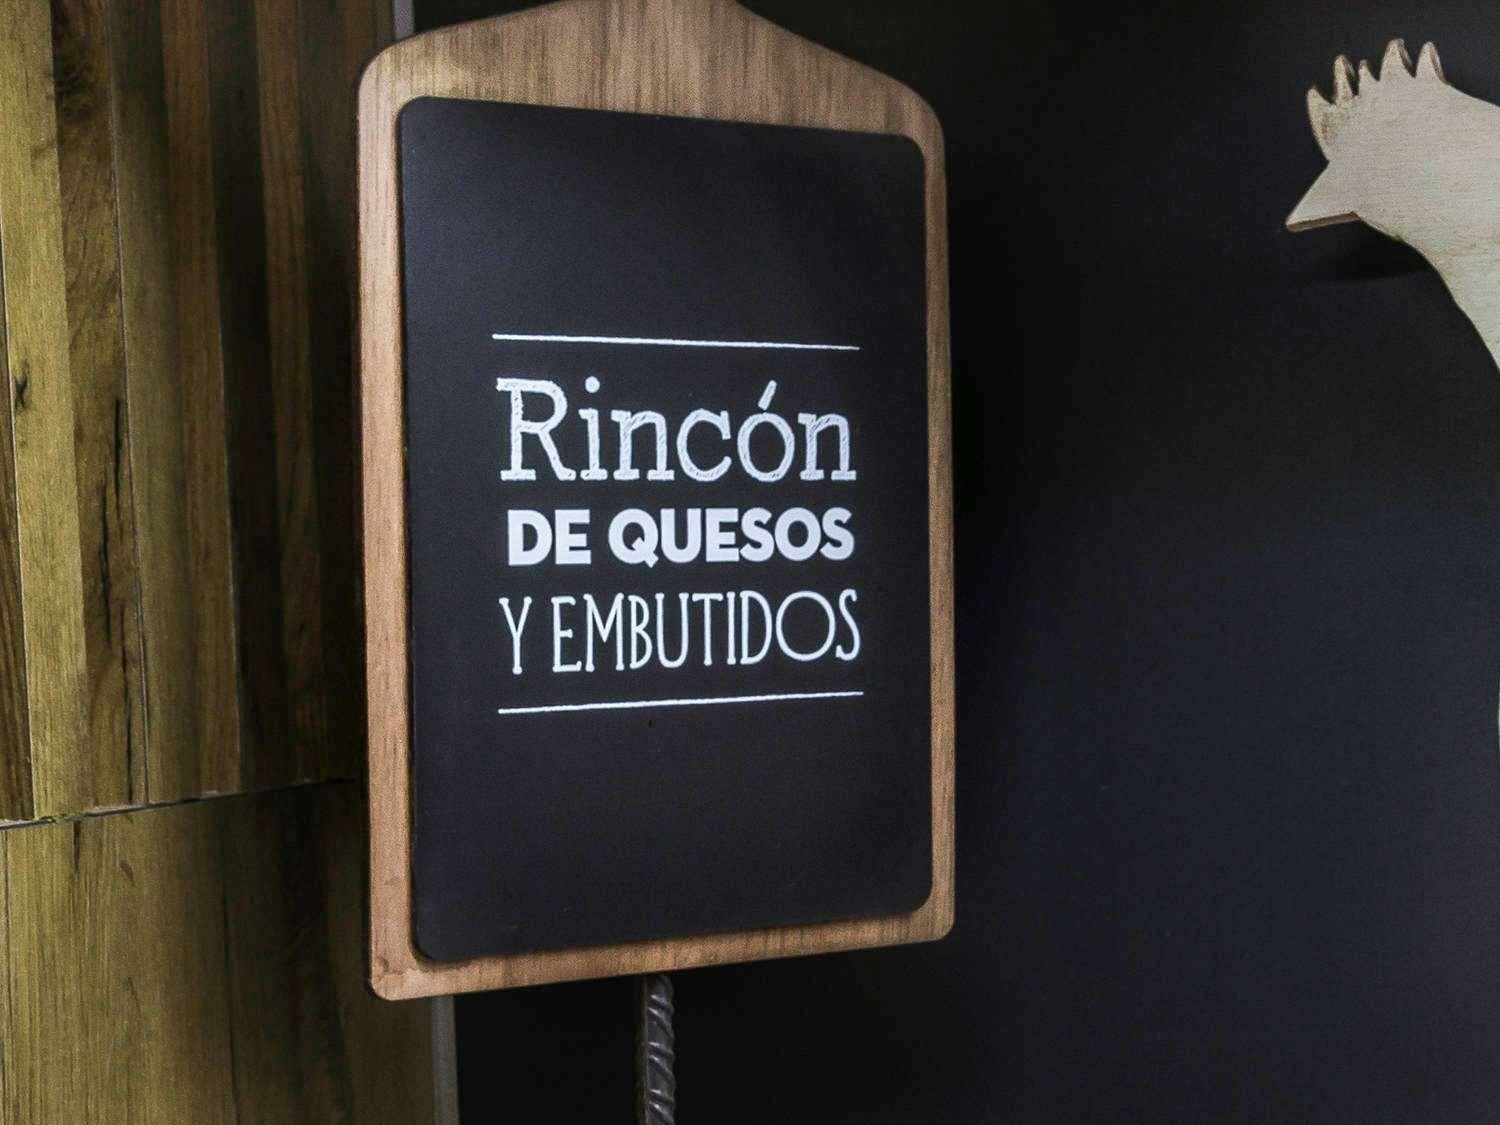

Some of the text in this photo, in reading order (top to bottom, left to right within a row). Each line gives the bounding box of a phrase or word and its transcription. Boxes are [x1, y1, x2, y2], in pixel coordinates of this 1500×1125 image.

[496, 375, 857, 482] Rincón
[507, 506, 855, 568] DE QUESOS
[498, 589, 861, 675] Y EMBUTIDOS
